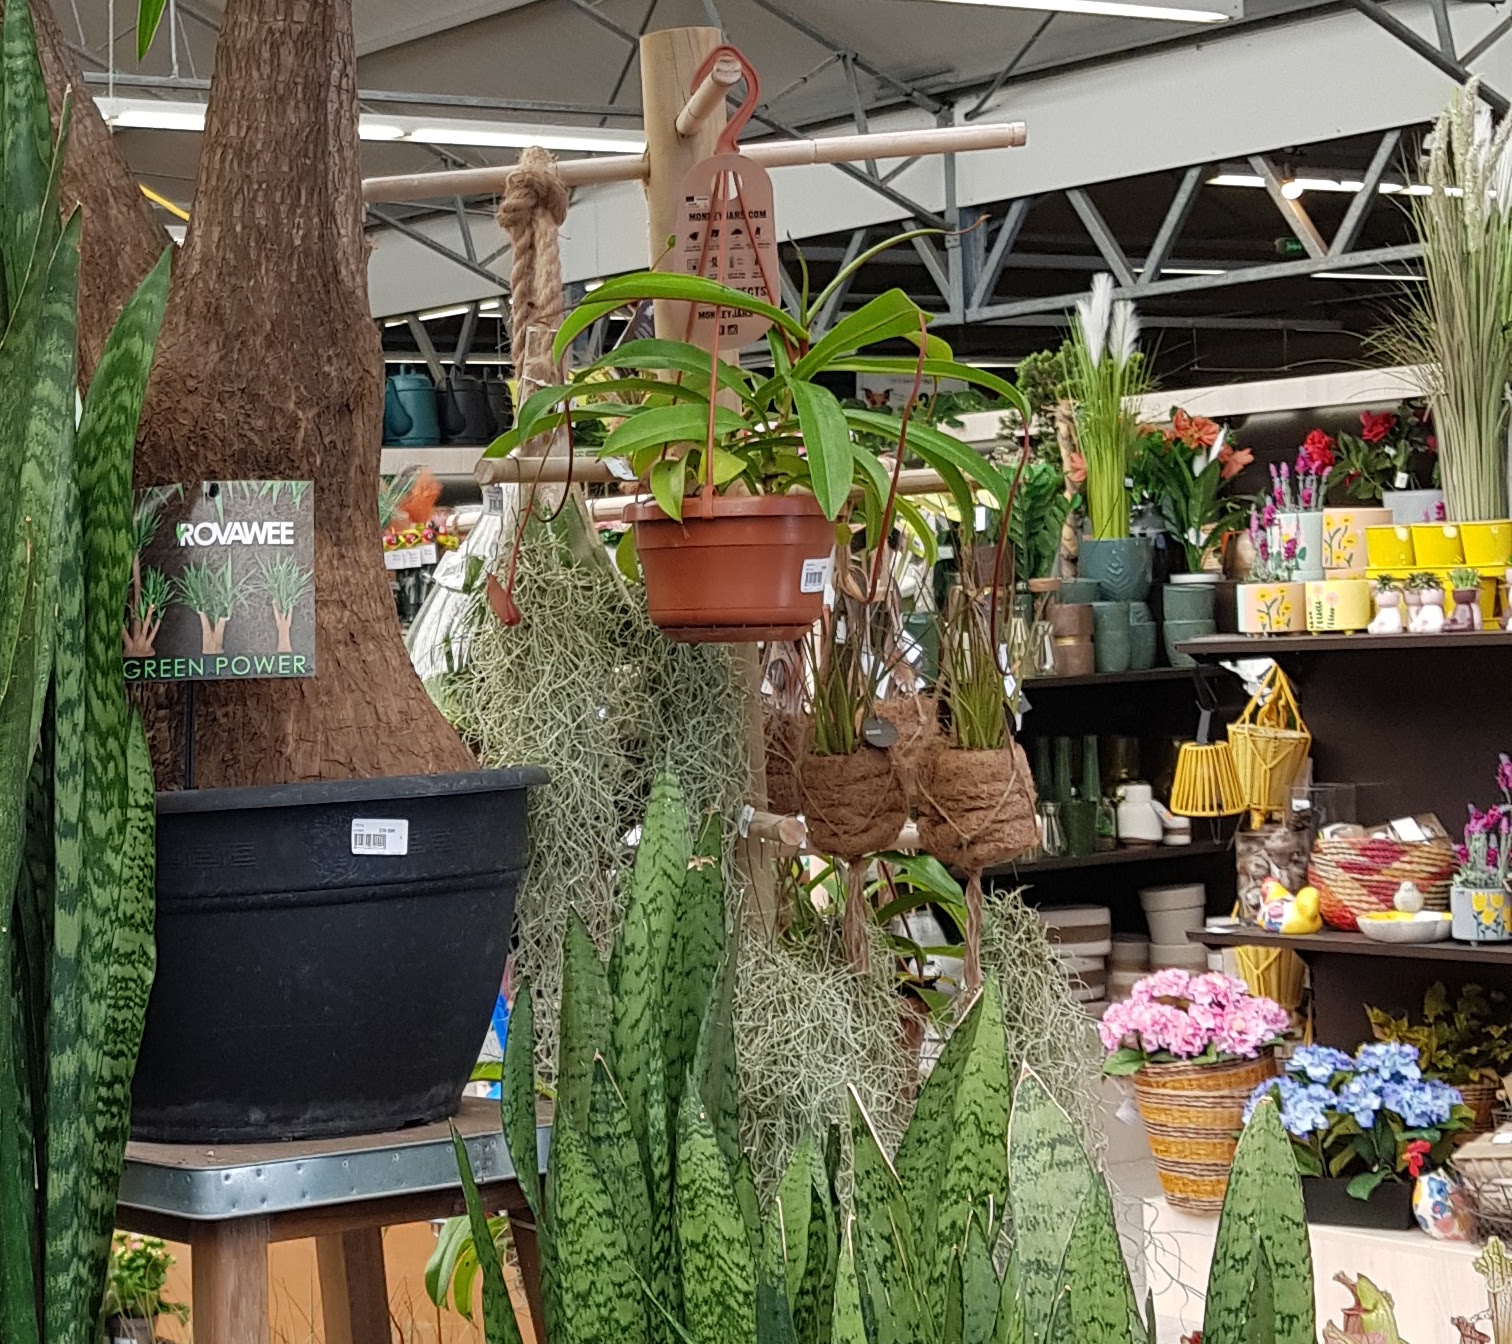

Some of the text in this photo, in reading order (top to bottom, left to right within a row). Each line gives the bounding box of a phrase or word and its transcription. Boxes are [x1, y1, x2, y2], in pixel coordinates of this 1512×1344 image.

[180, 521, 295, 547] ROVAWEE
[123, 655, 306, 680] GREEN POWER
